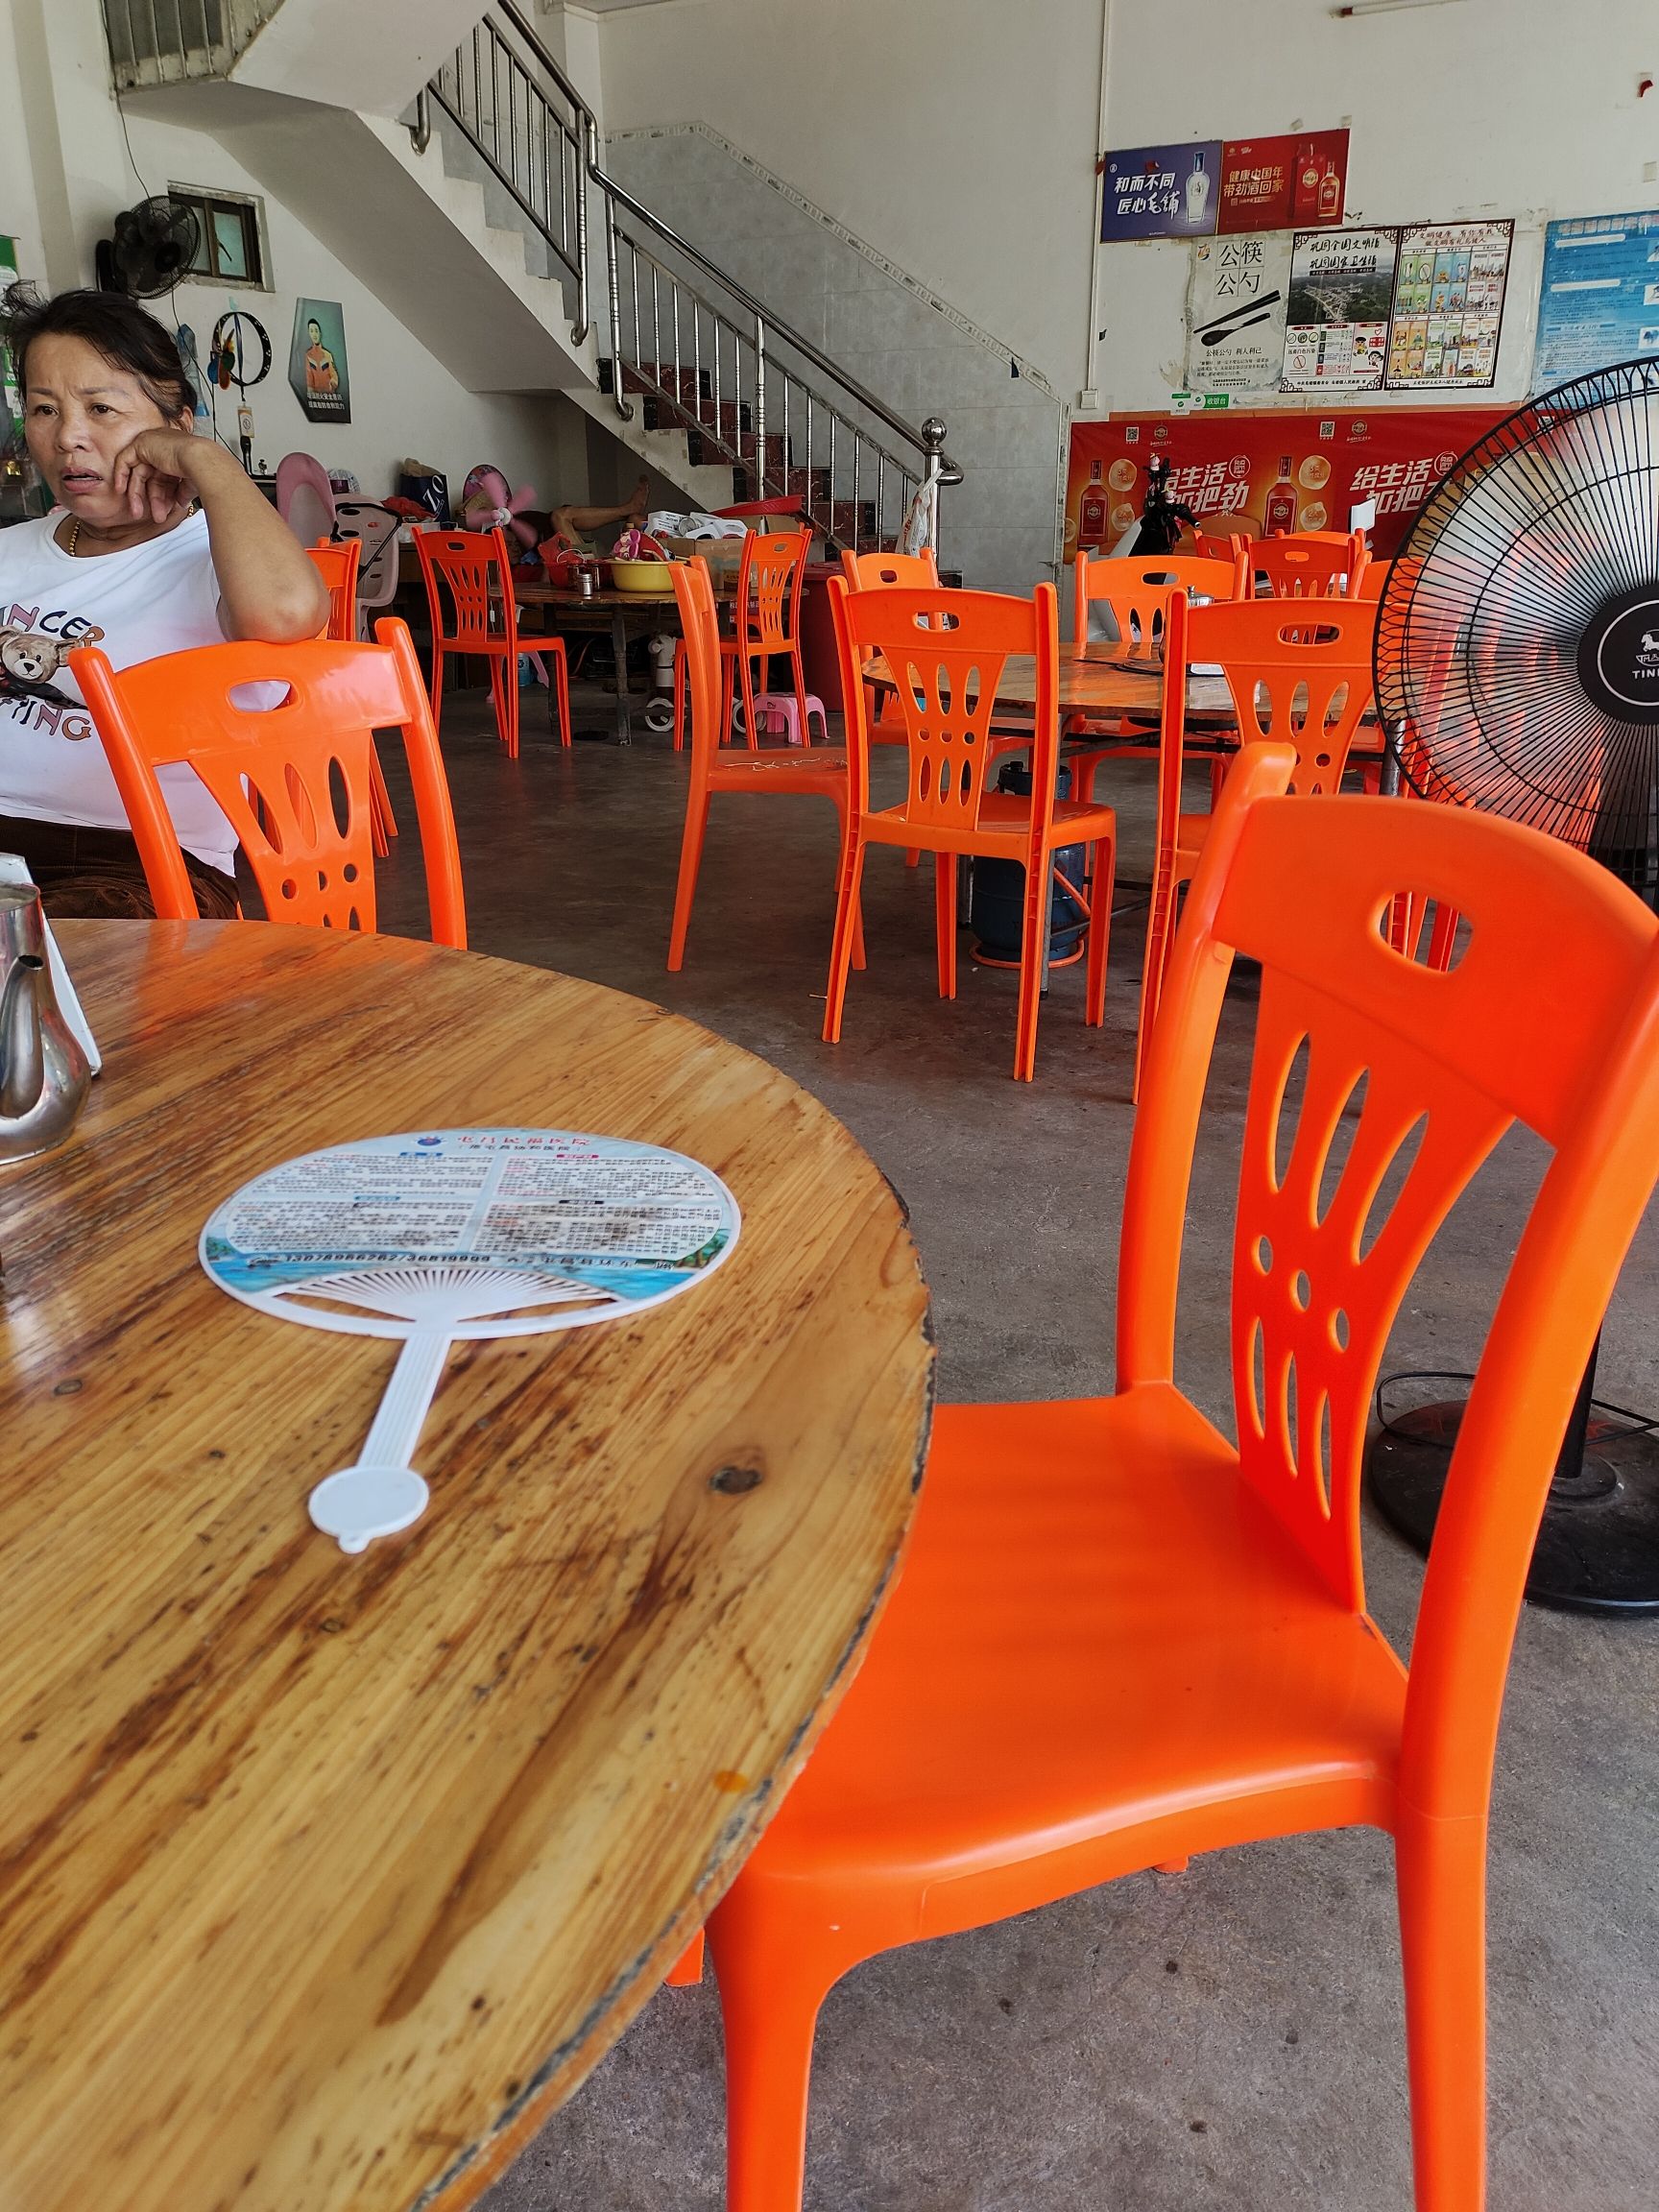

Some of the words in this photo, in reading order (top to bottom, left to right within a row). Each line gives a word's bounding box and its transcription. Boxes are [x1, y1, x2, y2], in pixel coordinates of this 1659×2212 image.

[1114, 172, 1176, 194] 和而不同
[1229, 166, 1284, 183] 健康中国年
[1223, 179, 1285, 198] 带劲酒回家
[1117, 190, 1181, 220] 匠心毛铺
[1219, 240, 1264, 269] 公筷
[1214, 272, 1262, 297] 公勺
[1207, 397, 1226, 405] 收银台
[1349, 457, 1433, 492] 给生活
[1632, 668, 1659, 680] TIN
